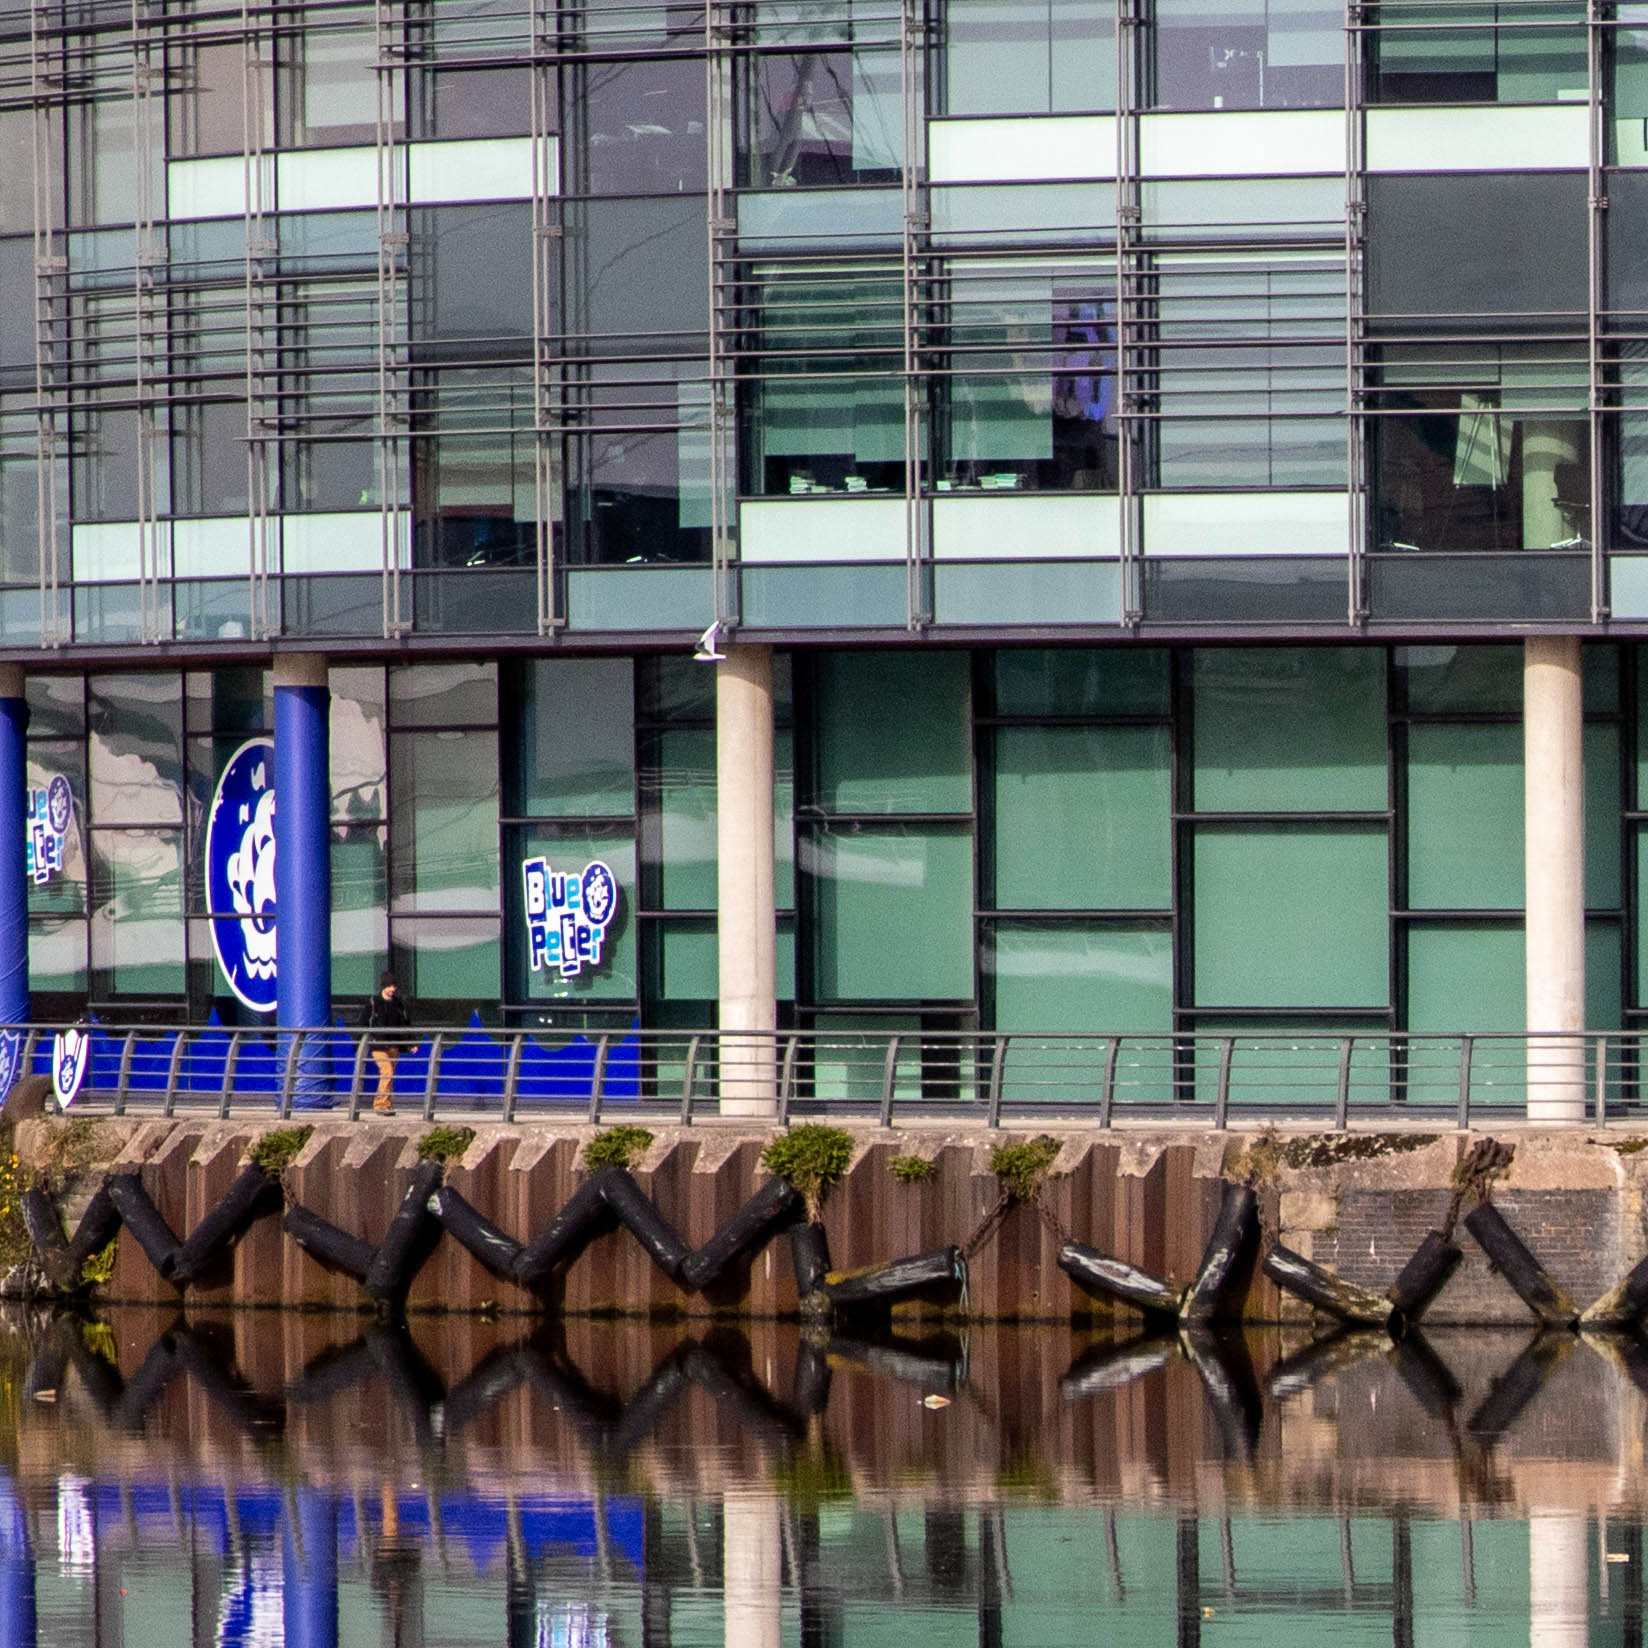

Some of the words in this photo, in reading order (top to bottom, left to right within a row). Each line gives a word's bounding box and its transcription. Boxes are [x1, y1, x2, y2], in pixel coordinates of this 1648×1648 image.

[27, 789, 48, 820] ue
[27, 824, 64, 881] eter
[525, 861, 582, 921] Blue
[530, 913, 602, 972] Peter
